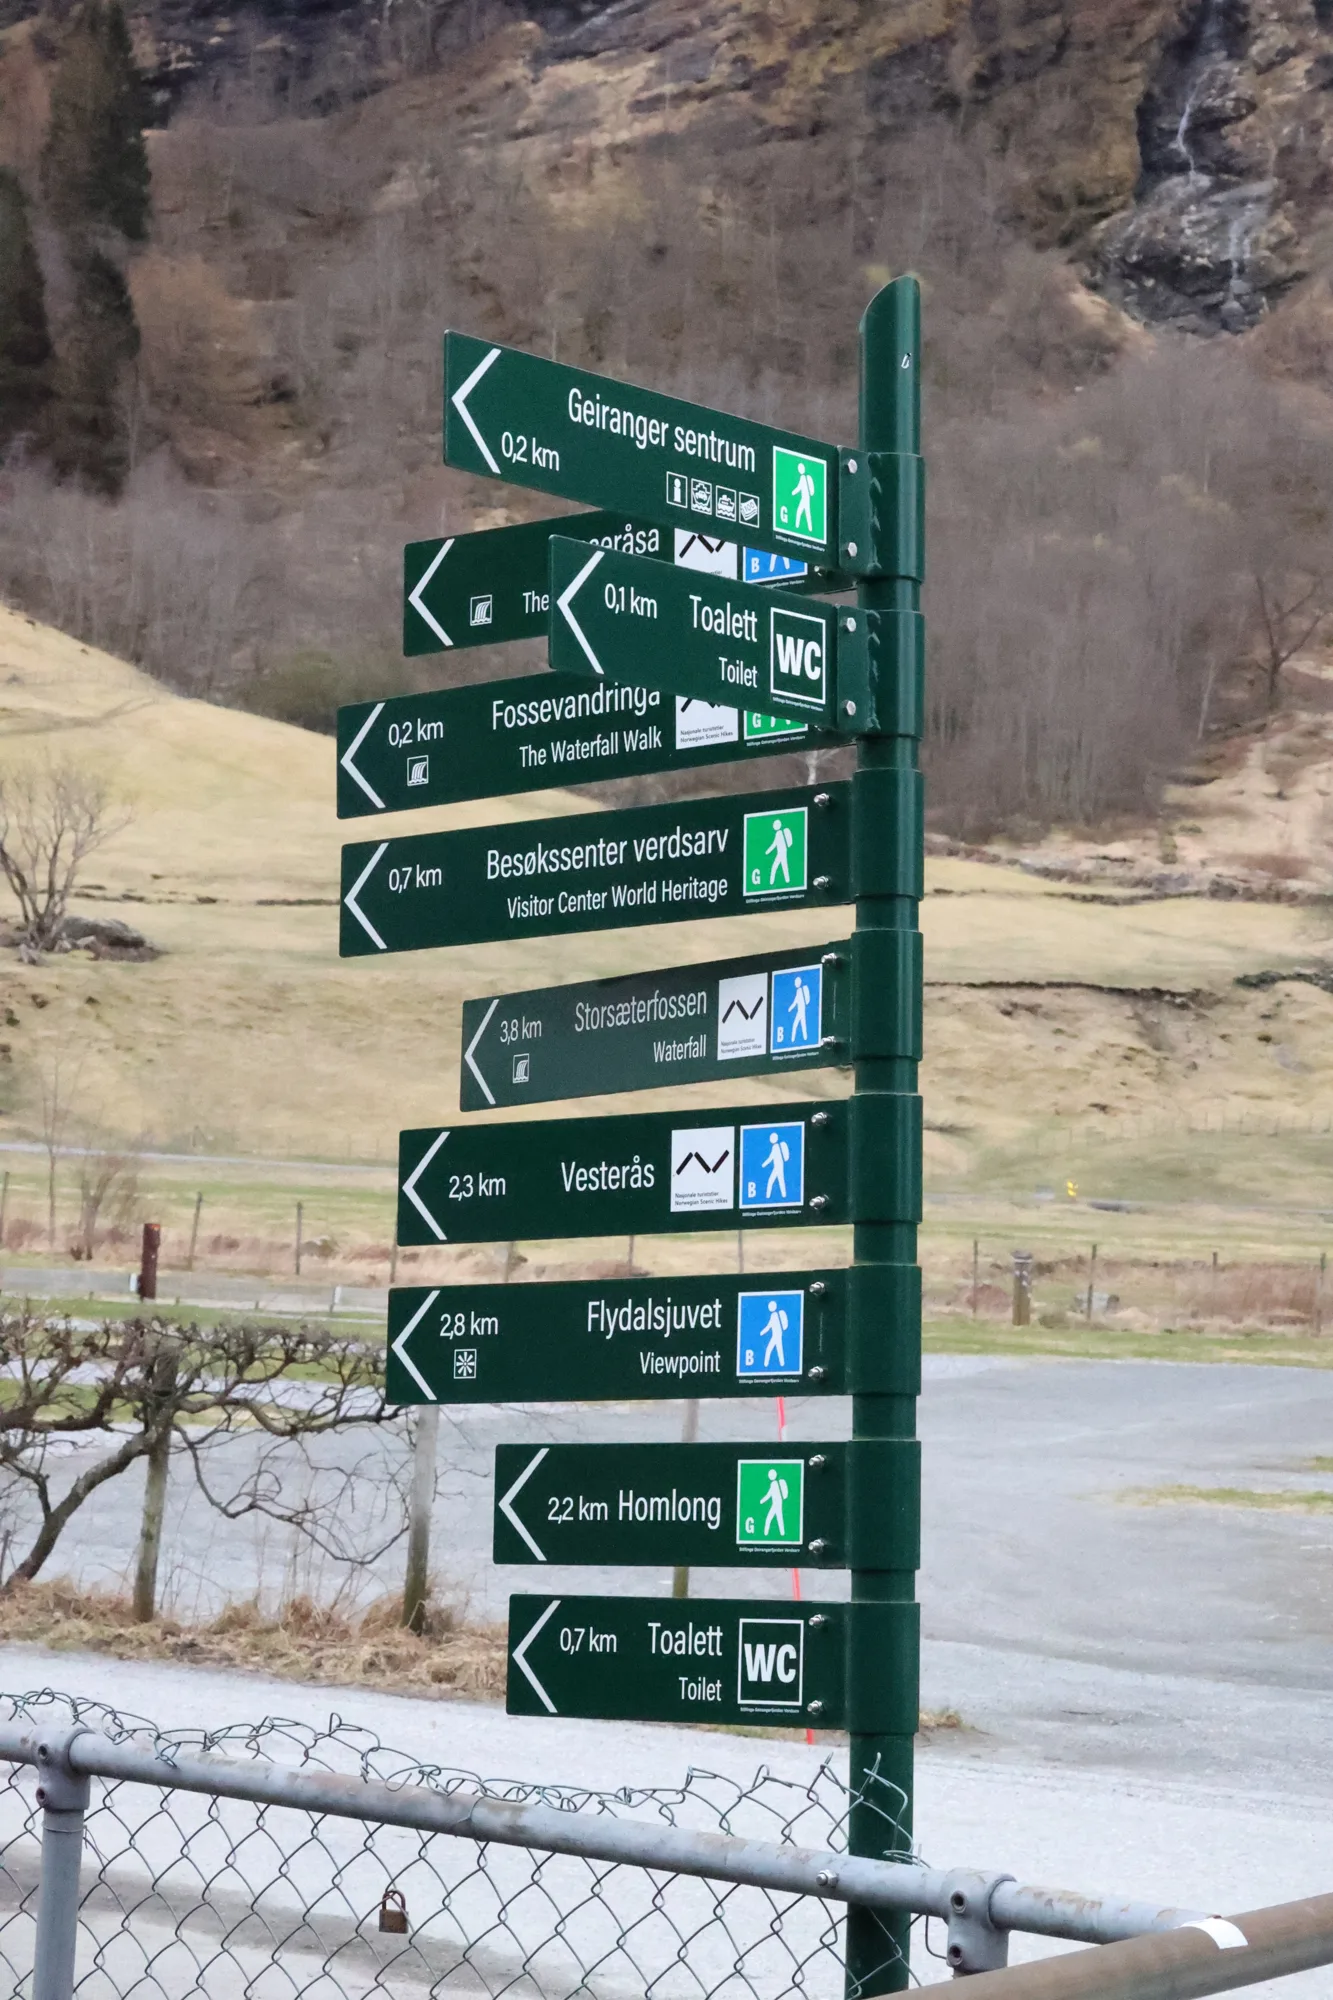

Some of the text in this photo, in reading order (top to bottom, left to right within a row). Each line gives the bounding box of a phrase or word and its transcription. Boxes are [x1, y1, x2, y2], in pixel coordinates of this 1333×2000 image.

[568, 387, 756, 473] Geiranger sentrum
[501, 431, 560, 472] 0,2 km
[780, 505, 788, 523] G
[580, 523, 660, 555] eråsa
[751, 557, 760, 573] B
[522, 590, 550, 614] The
[604, 583, 658, 619] 0,1 km
[688, 594, 758, 643] Toalett
[718, 656, 758, 689] Toilet
[775, 633, 822, 681] WC
[492, 683, 660, 731] Fossevandringa
[751, 712, 762, 729] G
[388, 717, 444, 749] 0,2 km
[518, 725, 662, 768] The Waterfall Walk
[487, 825, 729, 880] Besøkssenter verdsarv
[388, 863, 442, 894] 0,7 km
[751, 867, 761, 886] G
[507, 894, 555, 919] Visitor
[558, 889, 608, 914] Center
[611, 880, 657, 905] World
[661, 876, 728, 903] Heritage
[574, 989, 707, 1032] Storsæterfossen
[499, 1015, 542, 1046] 3,8 km
[776, 1026, 785, 1043] B
[653, 1034, 707, 1063] Waterfall
[448, 1172, 506, 1202] 2,3 km
[560, 1154, 655, 1192] Vesterås
[747, 1182, 757, 1198] B
[439, 1310, 499, 1340] 2,8 km
[587, 1296, 722, 1340] Flydalsjuvet
[639, 1350, 721, 1379] Viewpoint
[745, 1349, 755, 1366] B
[547, 1488, 721, 1530] 2,2 km Homlong
[745, 1516, 755, 1534] G
[559, 1626, 617, 1655] 0,7 km
[647, 1621, 724, 1657] Toalett
[743, 1643, 797, 1684] WC
[678, 1676, 722, 1702] Toilet
